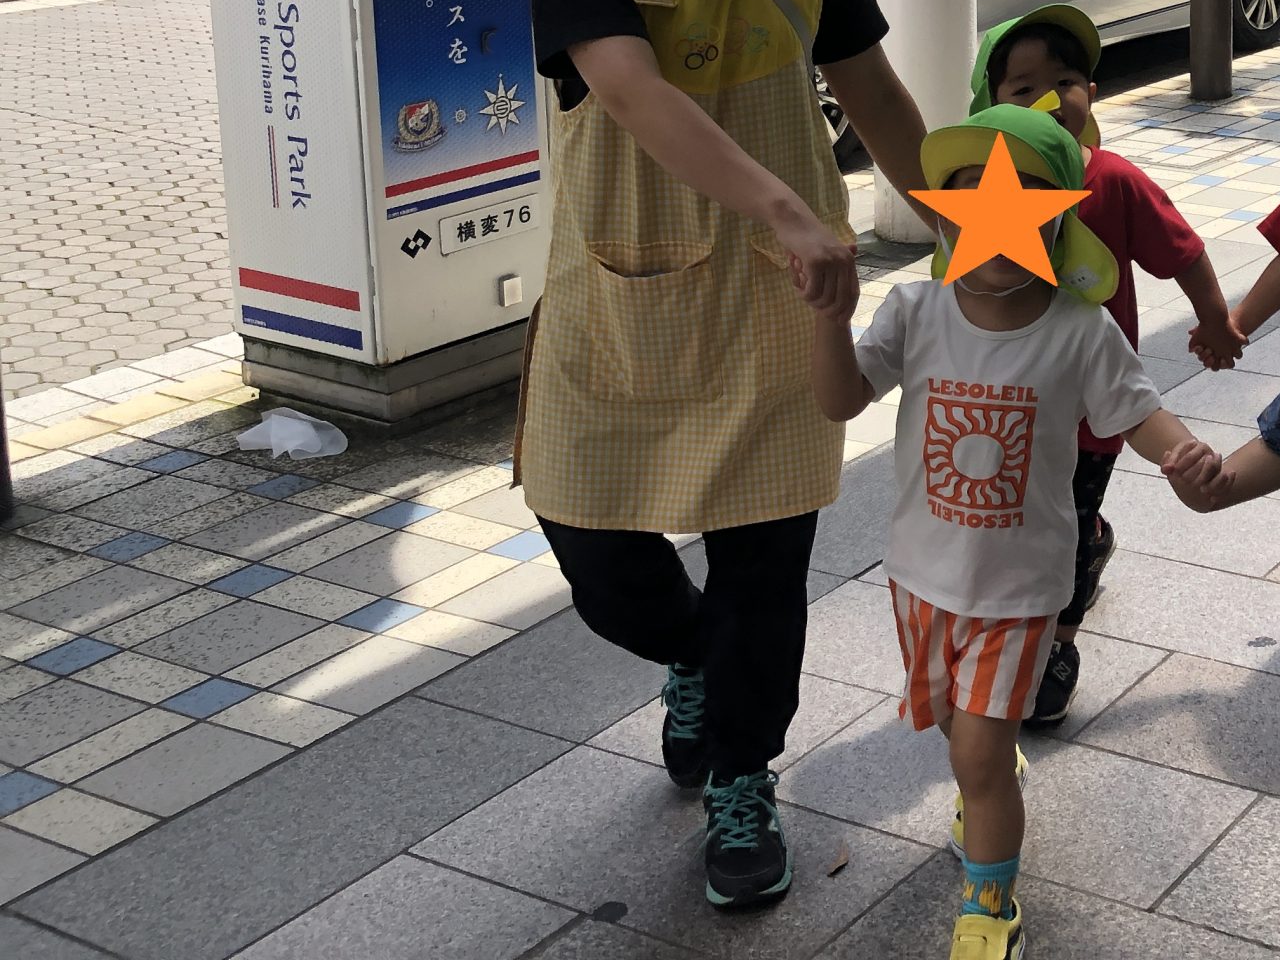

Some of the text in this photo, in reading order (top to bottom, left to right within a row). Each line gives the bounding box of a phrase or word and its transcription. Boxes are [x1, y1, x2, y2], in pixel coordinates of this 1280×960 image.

[259, 35, 274, 115] Kurihama
[273, 1, 303, 121] Sports
[287, 135, 312, 210] Park
[928, 378, 1039, 403] LESOLEIL
[928, 499, 1024, 528] LESOLEIL
